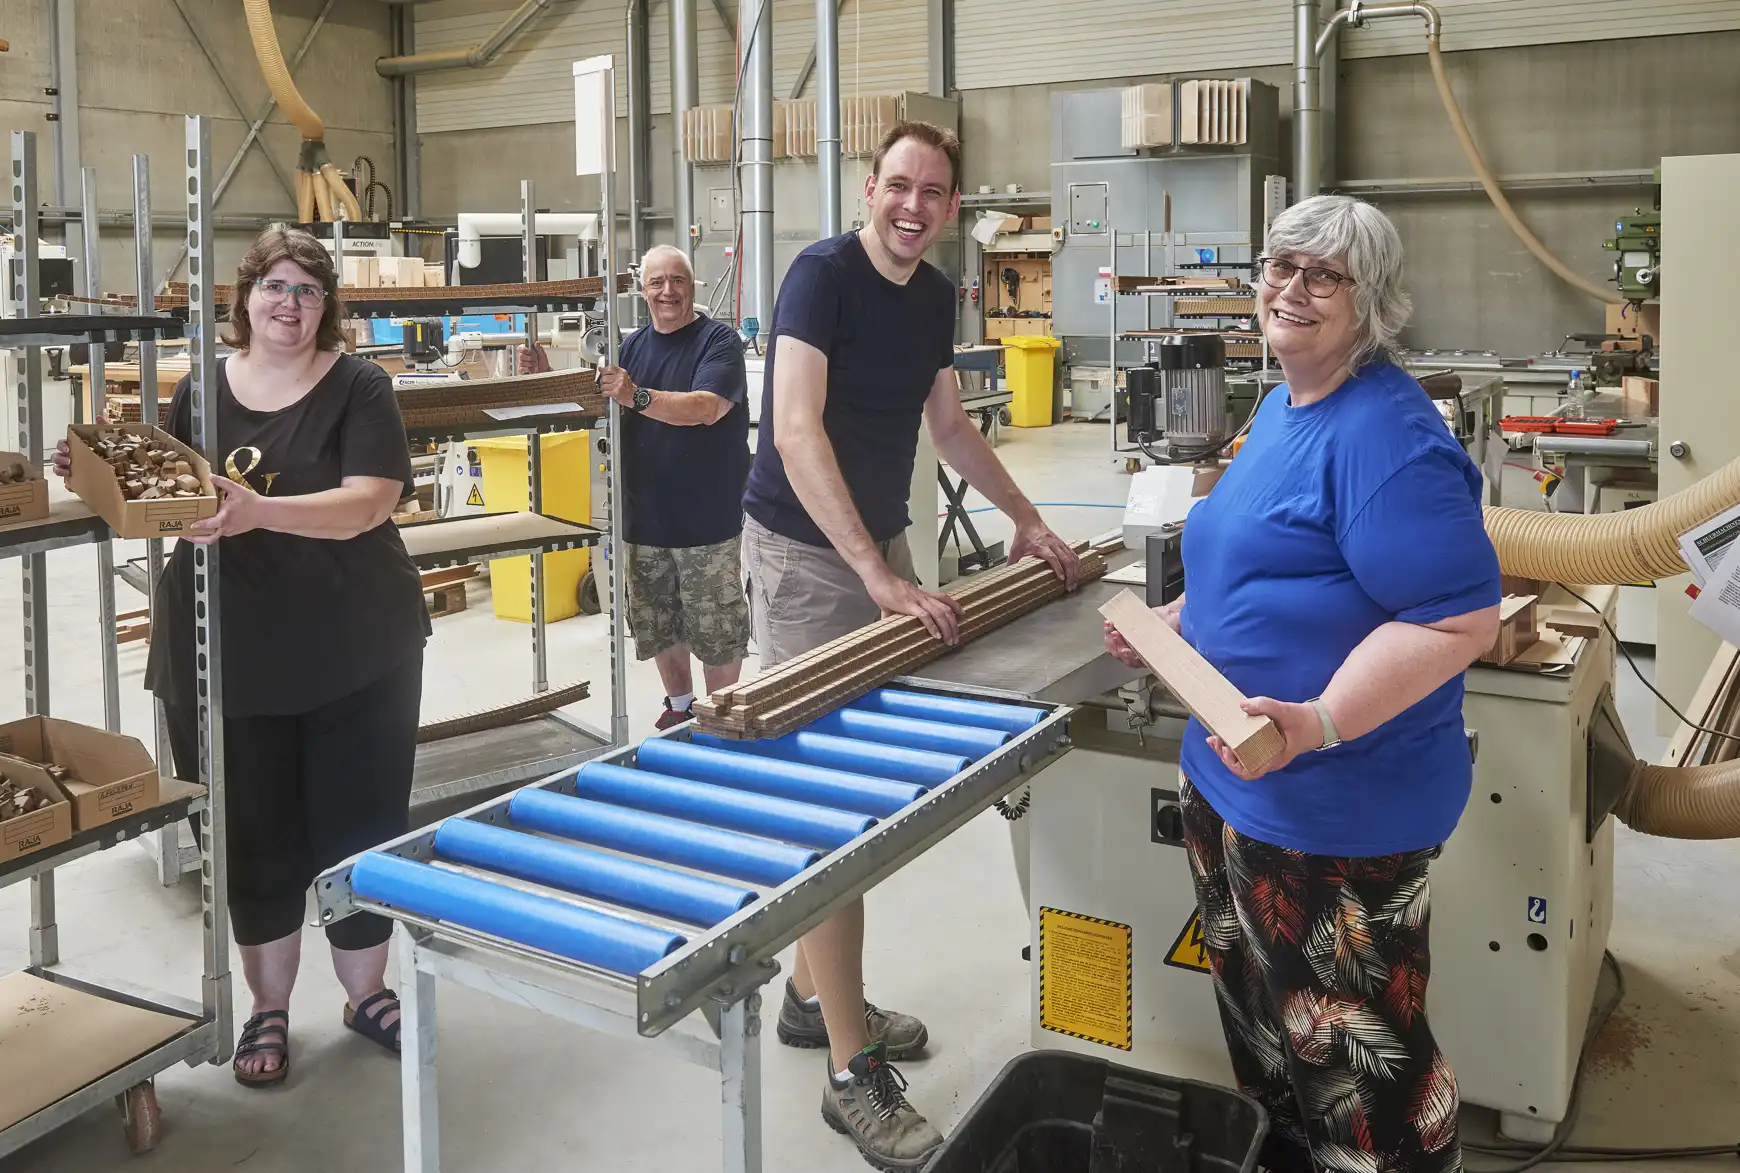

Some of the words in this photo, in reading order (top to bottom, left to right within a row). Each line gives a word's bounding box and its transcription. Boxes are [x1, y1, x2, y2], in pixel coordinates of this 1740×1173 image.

[159, 521, 183, 529] RAJA
[112, 802, 133, 814] RAJA
[18, 835, 41, 849] RAJA
